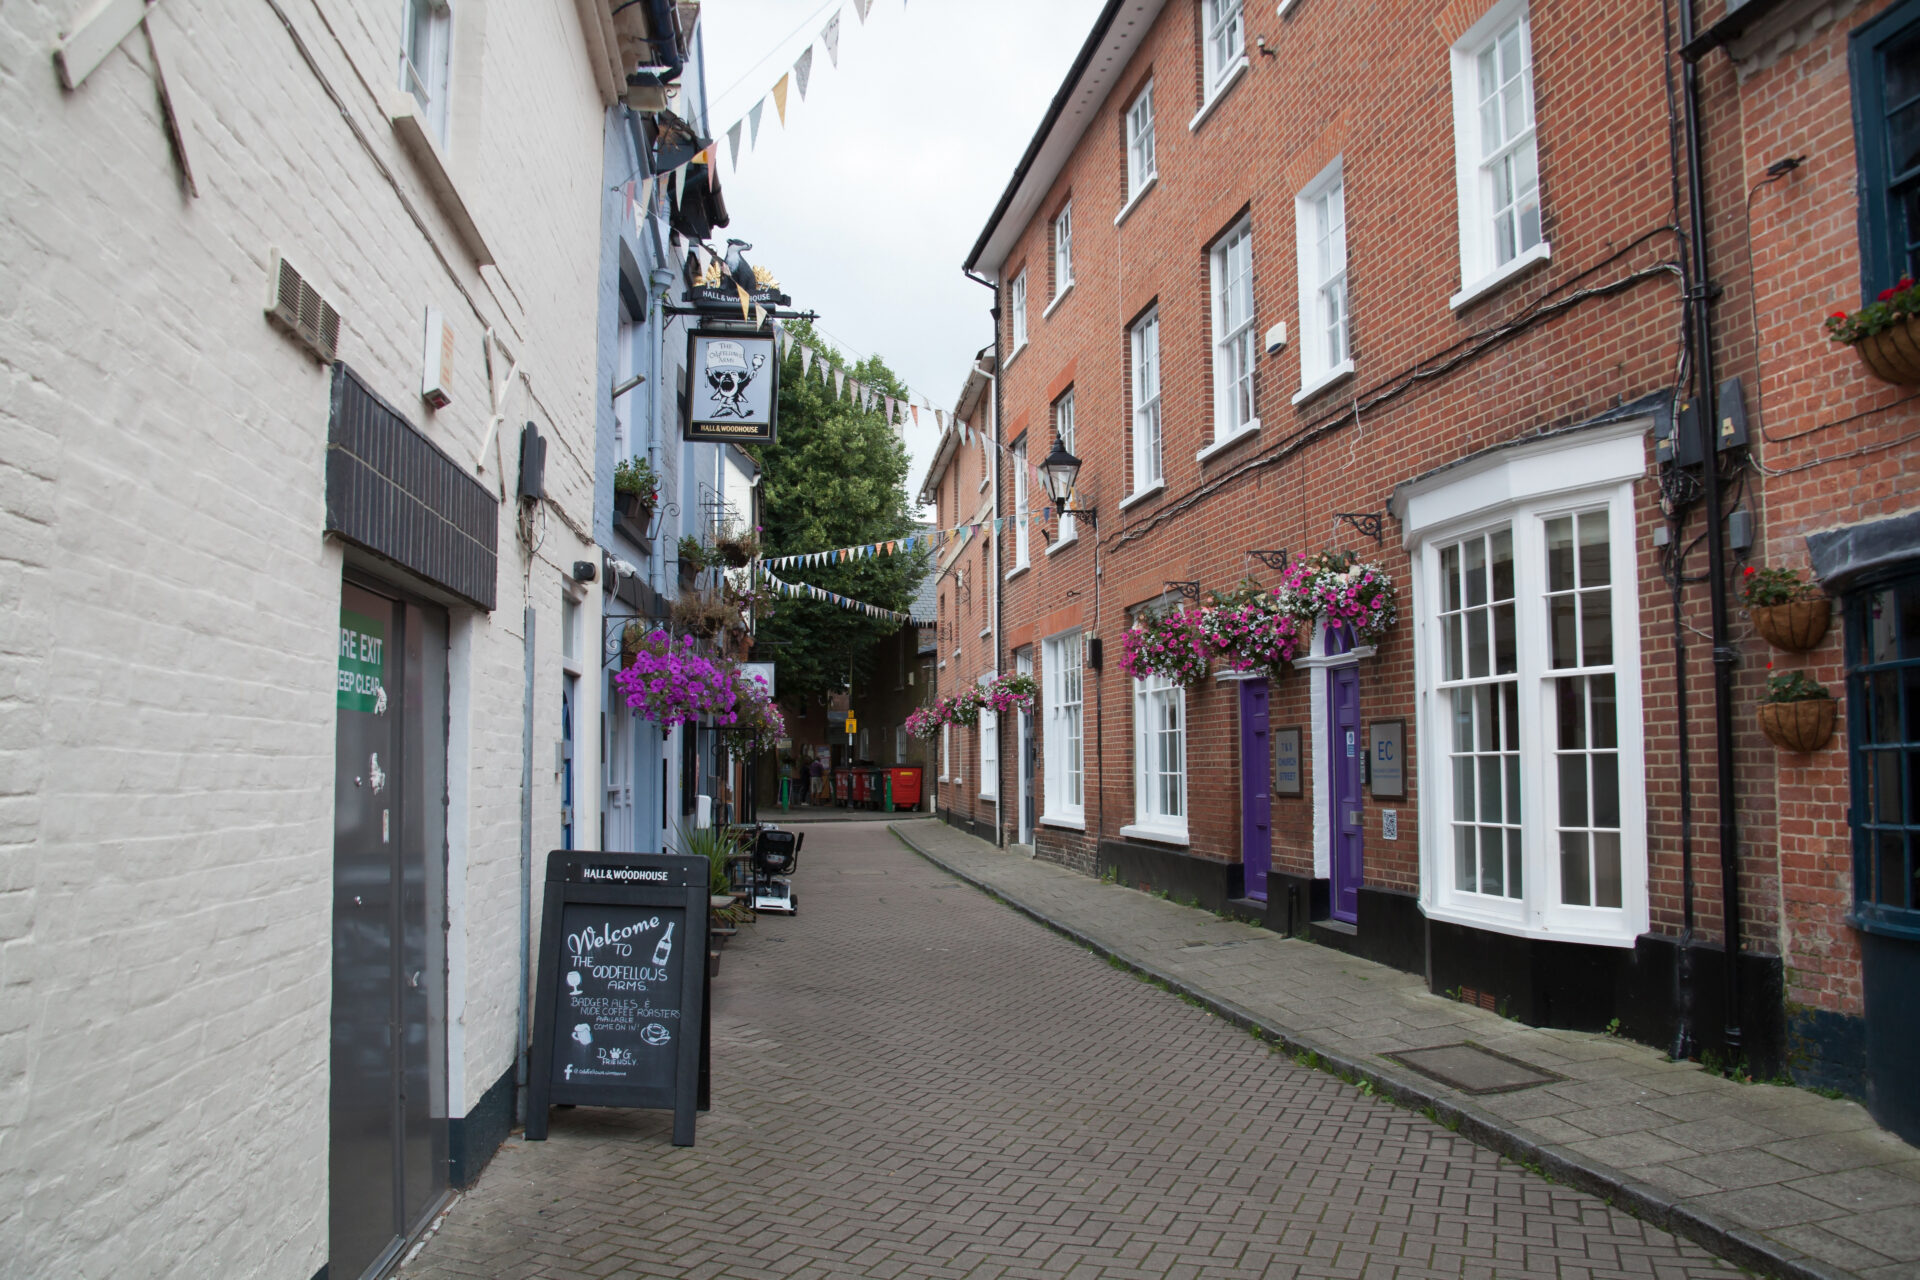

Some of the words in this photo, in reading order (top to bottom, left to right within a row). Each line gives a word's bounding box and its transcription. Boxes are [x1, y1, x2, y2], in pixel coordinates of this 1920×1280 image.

[339, 627, 357, 659] IRE
[360, 633, 383, 665] EXIT
[338, 669, 355, 692] EEP
[355, 672, 381, 696] CLEAR
[1378, 740, 1393, 761] EC
[567, 916, 660, 955] Welcome
[612, 942, 632, 957] TO
[571, 955, 594, 968] THE
[592, 965, 668, 982] ODDFELLOWS
[570, 996, 609, 1008] BADGER
[610, 998, 639, 1010] ALES
[596, 1015, 634, 1024] AVAILABLE
[602, 1007, 635, 1017] COFFEE
[636, 1008, 681, 1019] ROASTERS
[593, 1023, 614, 1031] COME
[615, 1023, 626, 1031] ON
